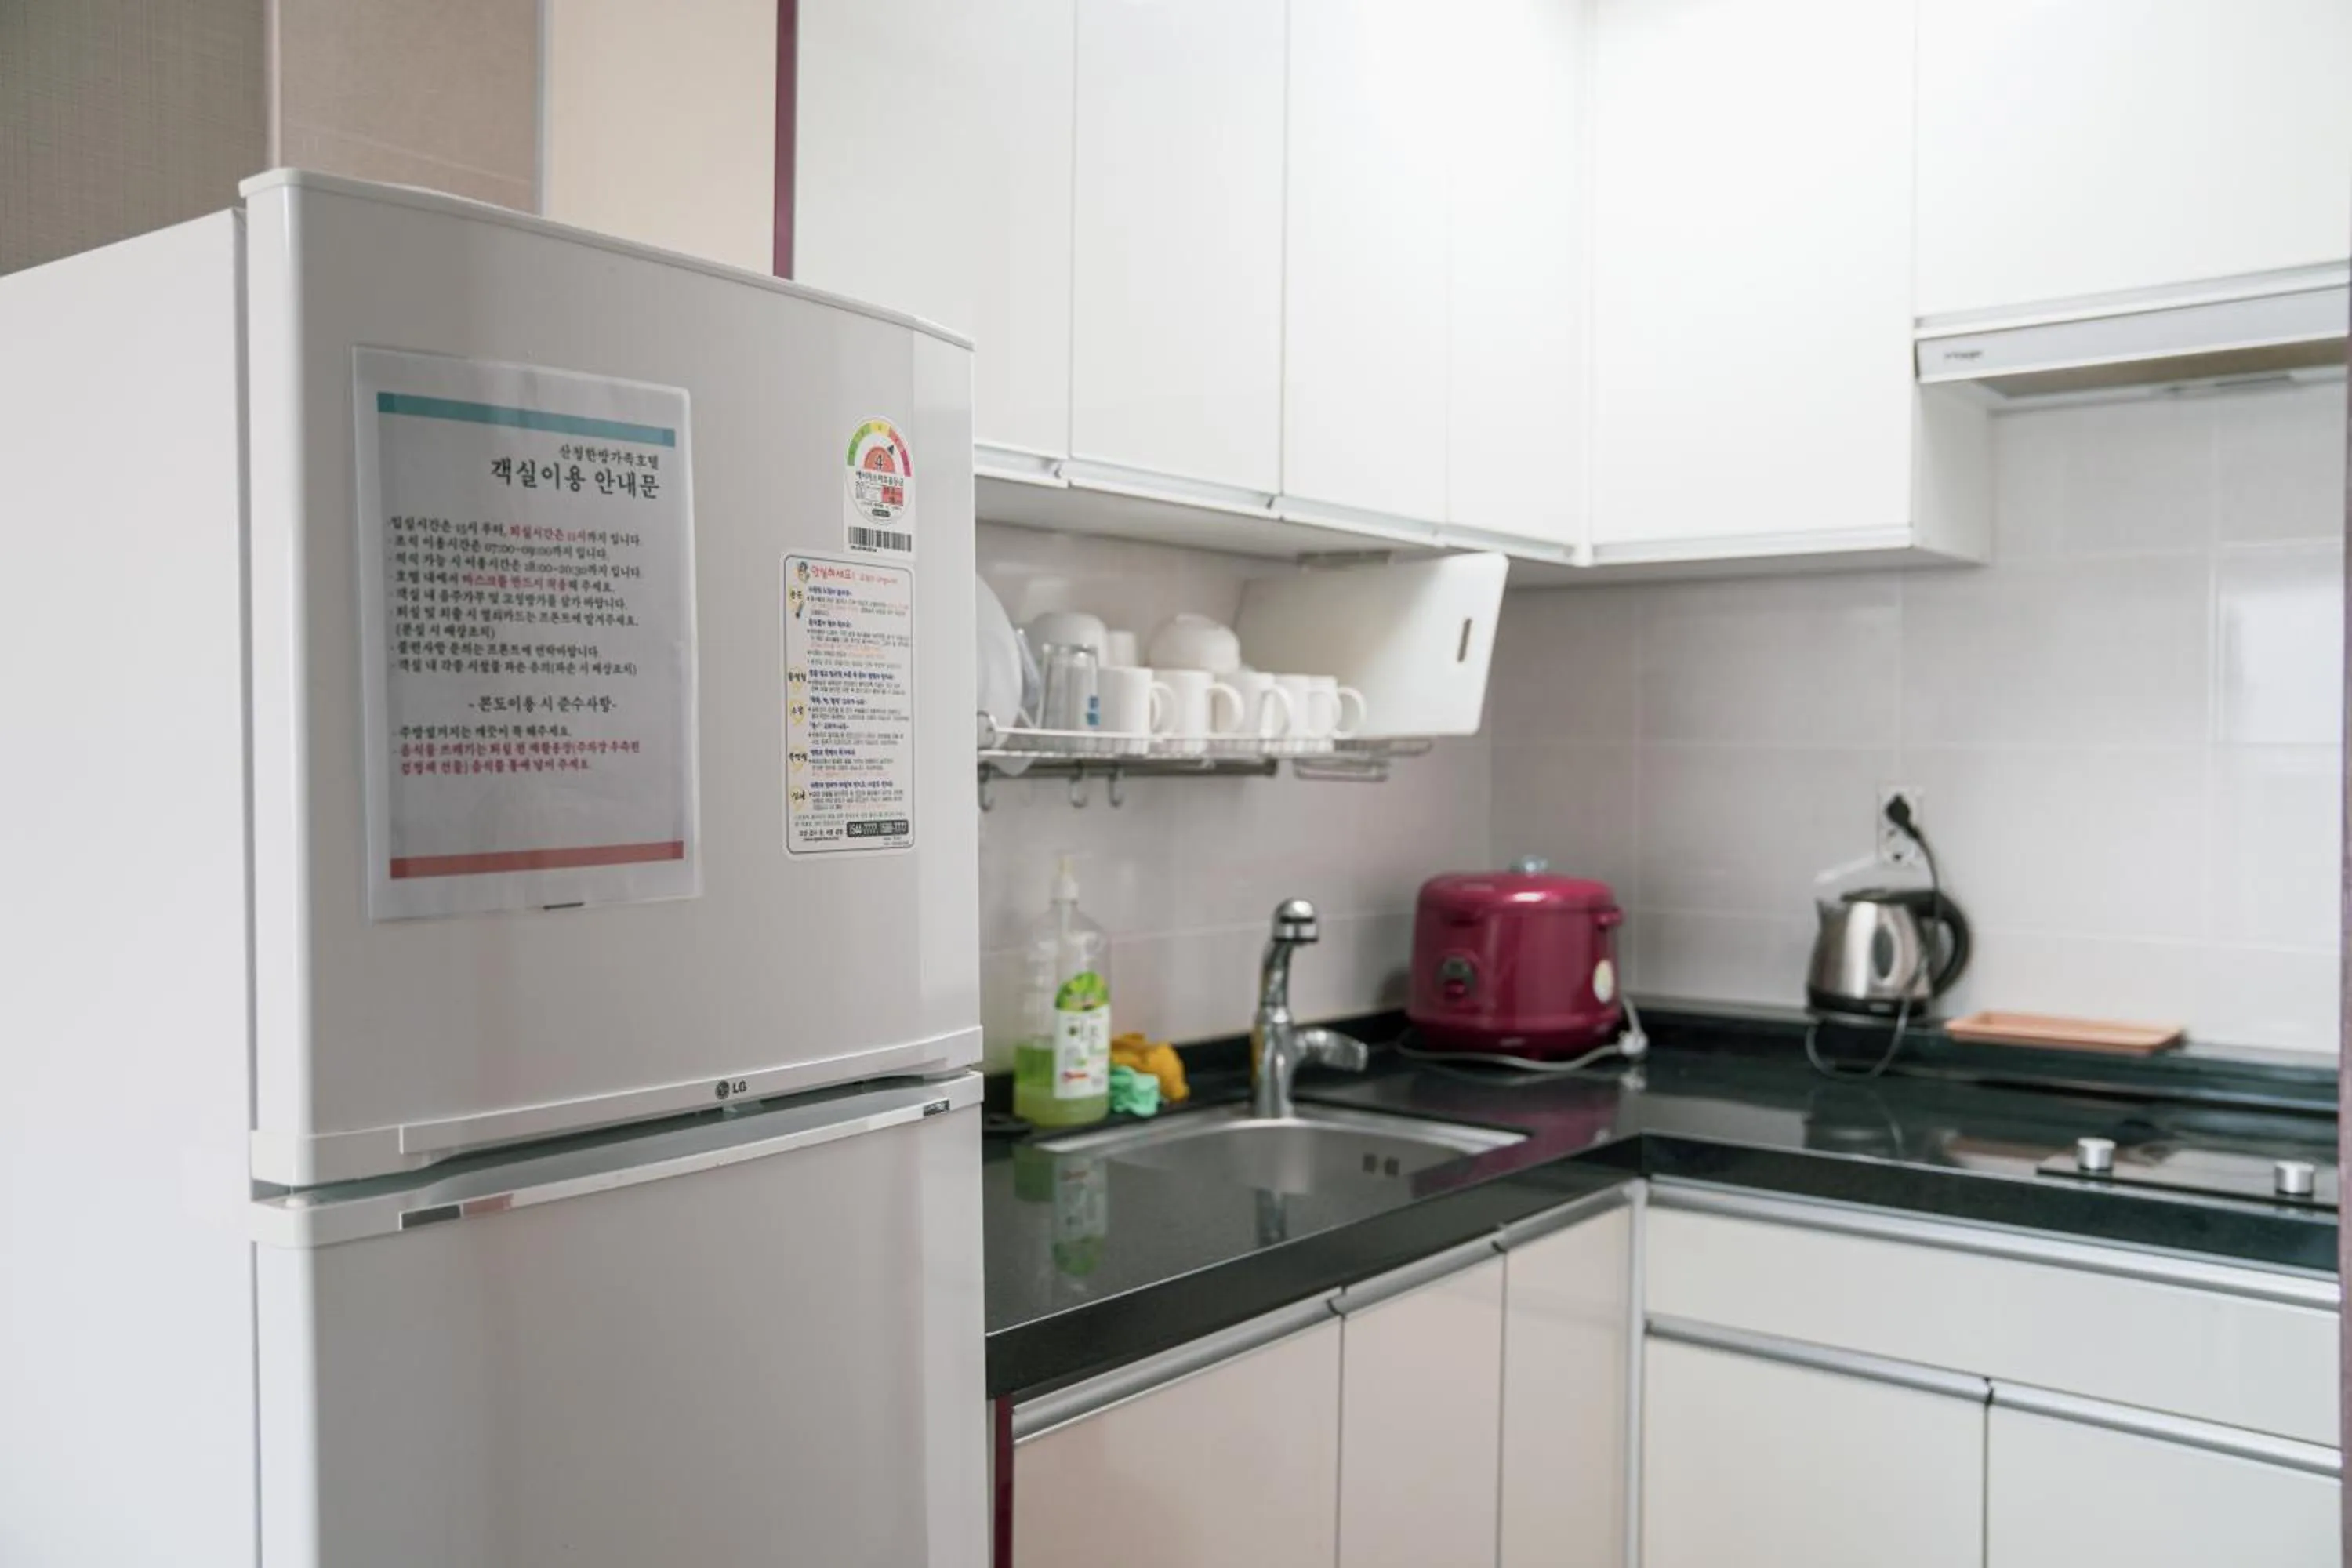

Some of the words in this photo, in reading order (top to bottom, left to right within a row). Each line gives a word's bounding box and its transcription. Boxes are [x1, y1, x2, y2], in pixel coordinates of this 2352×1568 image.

[875, 454, 883, 469] 4
[491, 456, 586, 492] 객실이용
[594, 468, 660, 499] 안내문
[423, 535, 481, 553] 이용시간은
[452, 554, 461, 568] 시
[465, 555, 521, 572] 이용시간은
[396, 569, 419, 584] 호텔
[397, 586, 419, 602] 객실
[424, 588, 435, 601] 내
[467, 607, 477, 621] 시
[430, 623, 439, 637] 시
[399, 659, 421, 673] 객실
[426, 659, 437, 673] 내
[540, 695, 553, 713] 시
[732, 1079, 747, 1094] LG
